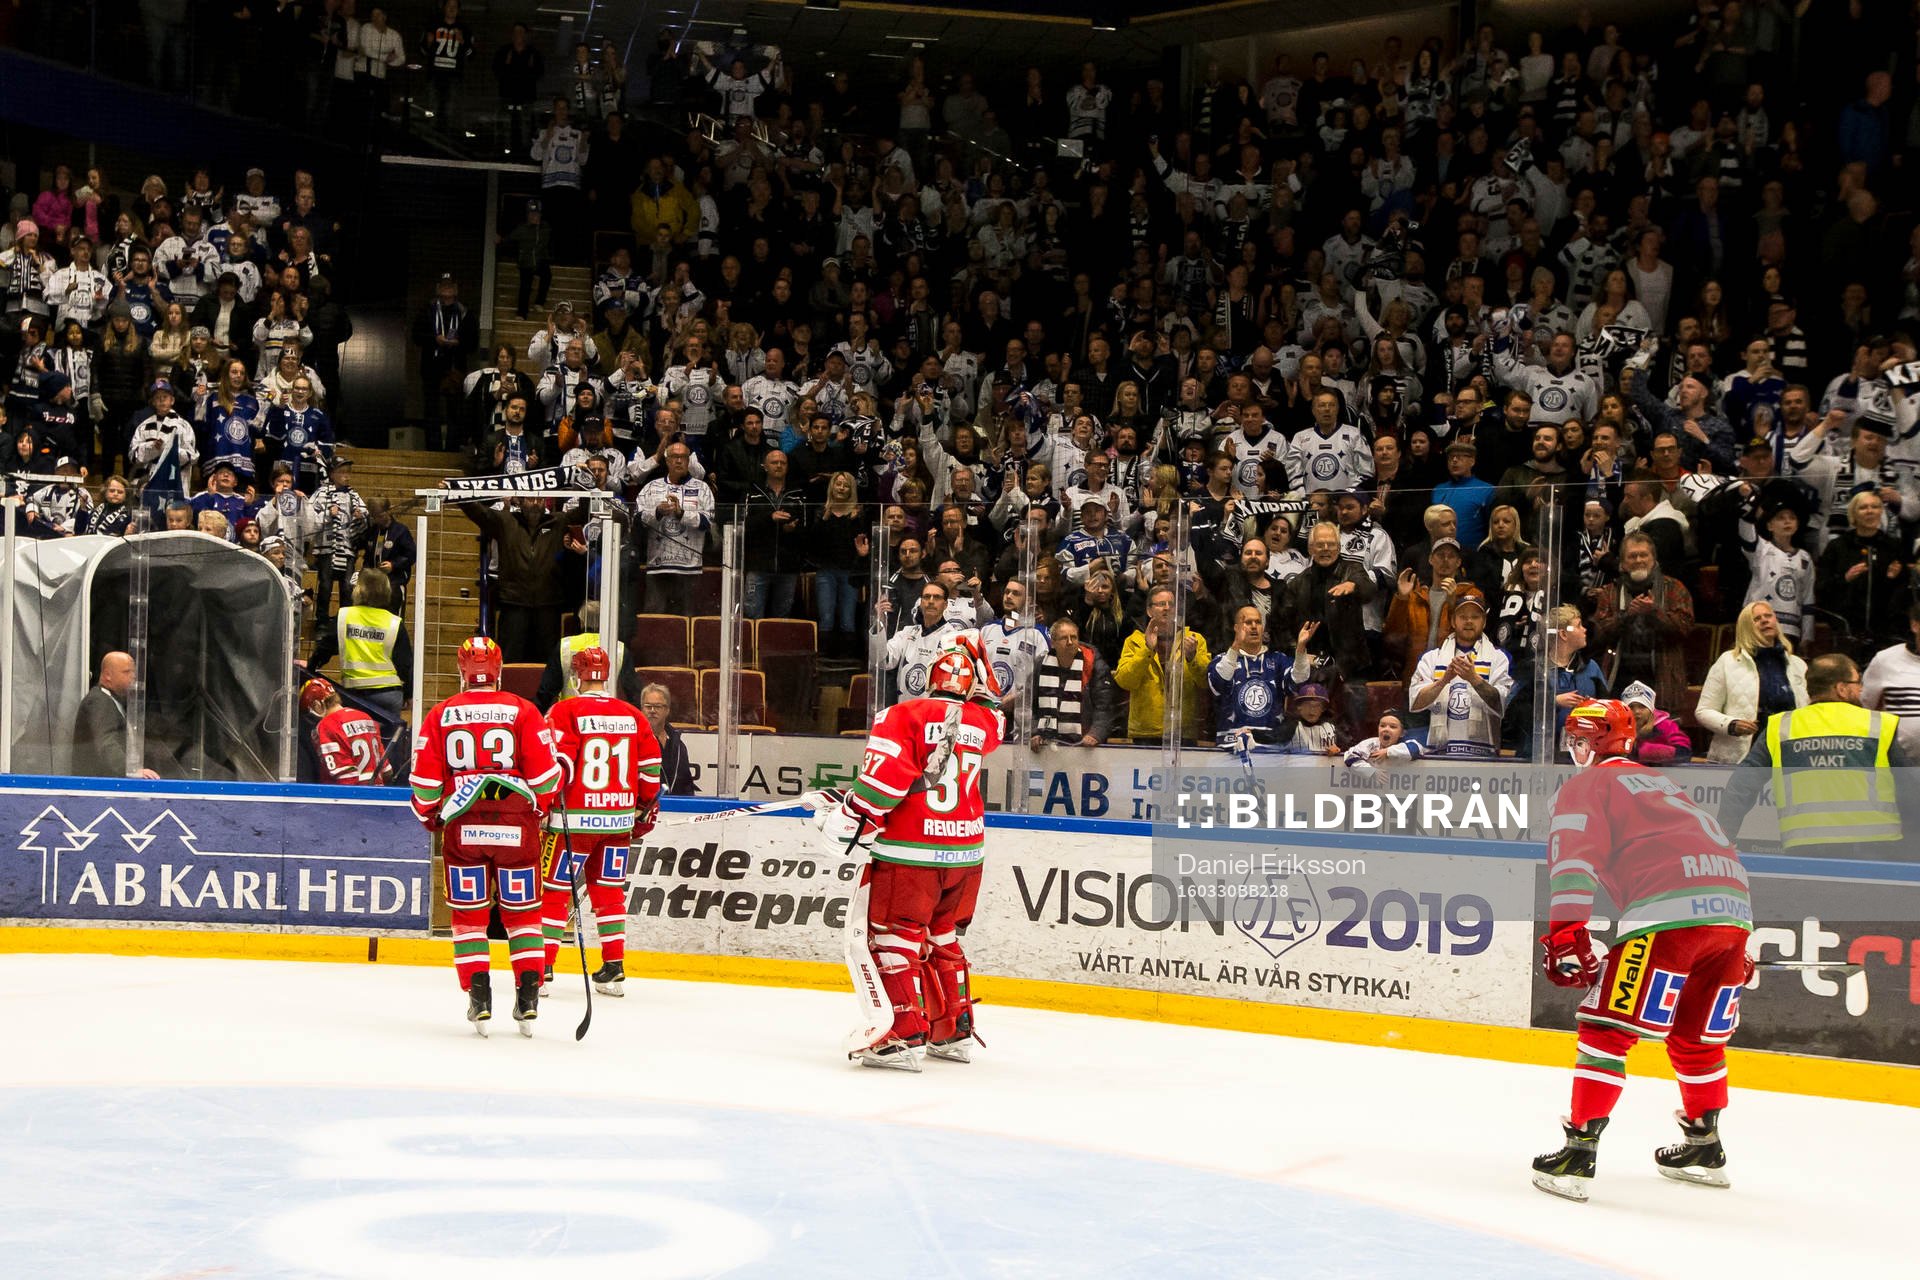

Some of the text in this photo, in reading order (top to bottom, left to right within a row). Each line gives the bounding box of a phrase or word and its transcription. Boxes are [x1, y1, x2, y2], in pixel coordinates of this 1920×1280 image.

[446, 729, 516, 772] 93
[1793, 738, 1864, 752] ORDNINGS
[582, 737, 631, 791] 81
[862, 752, 885, 776] 37
[1809, 754, 1846, 768] VAKT
[1390, 774, 1420, 791] ner
[1489, 772, 1522, 795] och
[580, 815, 634, 828] HOLMEN
[479, 831, 519, 840] Progress
[1552, 834, 1560, 862] 6
[761, 858, 816, 878] 070
[69, 862, 146, 906] AB
[160, 864, 287, 911] KARL
[1012, 866, 1226, 936] VISION
[1326, 886, 1495, 957] 2019
[1078, 948, 1411, 1001] VÅRT ANTAL ÄR VÅR STYRKA!
